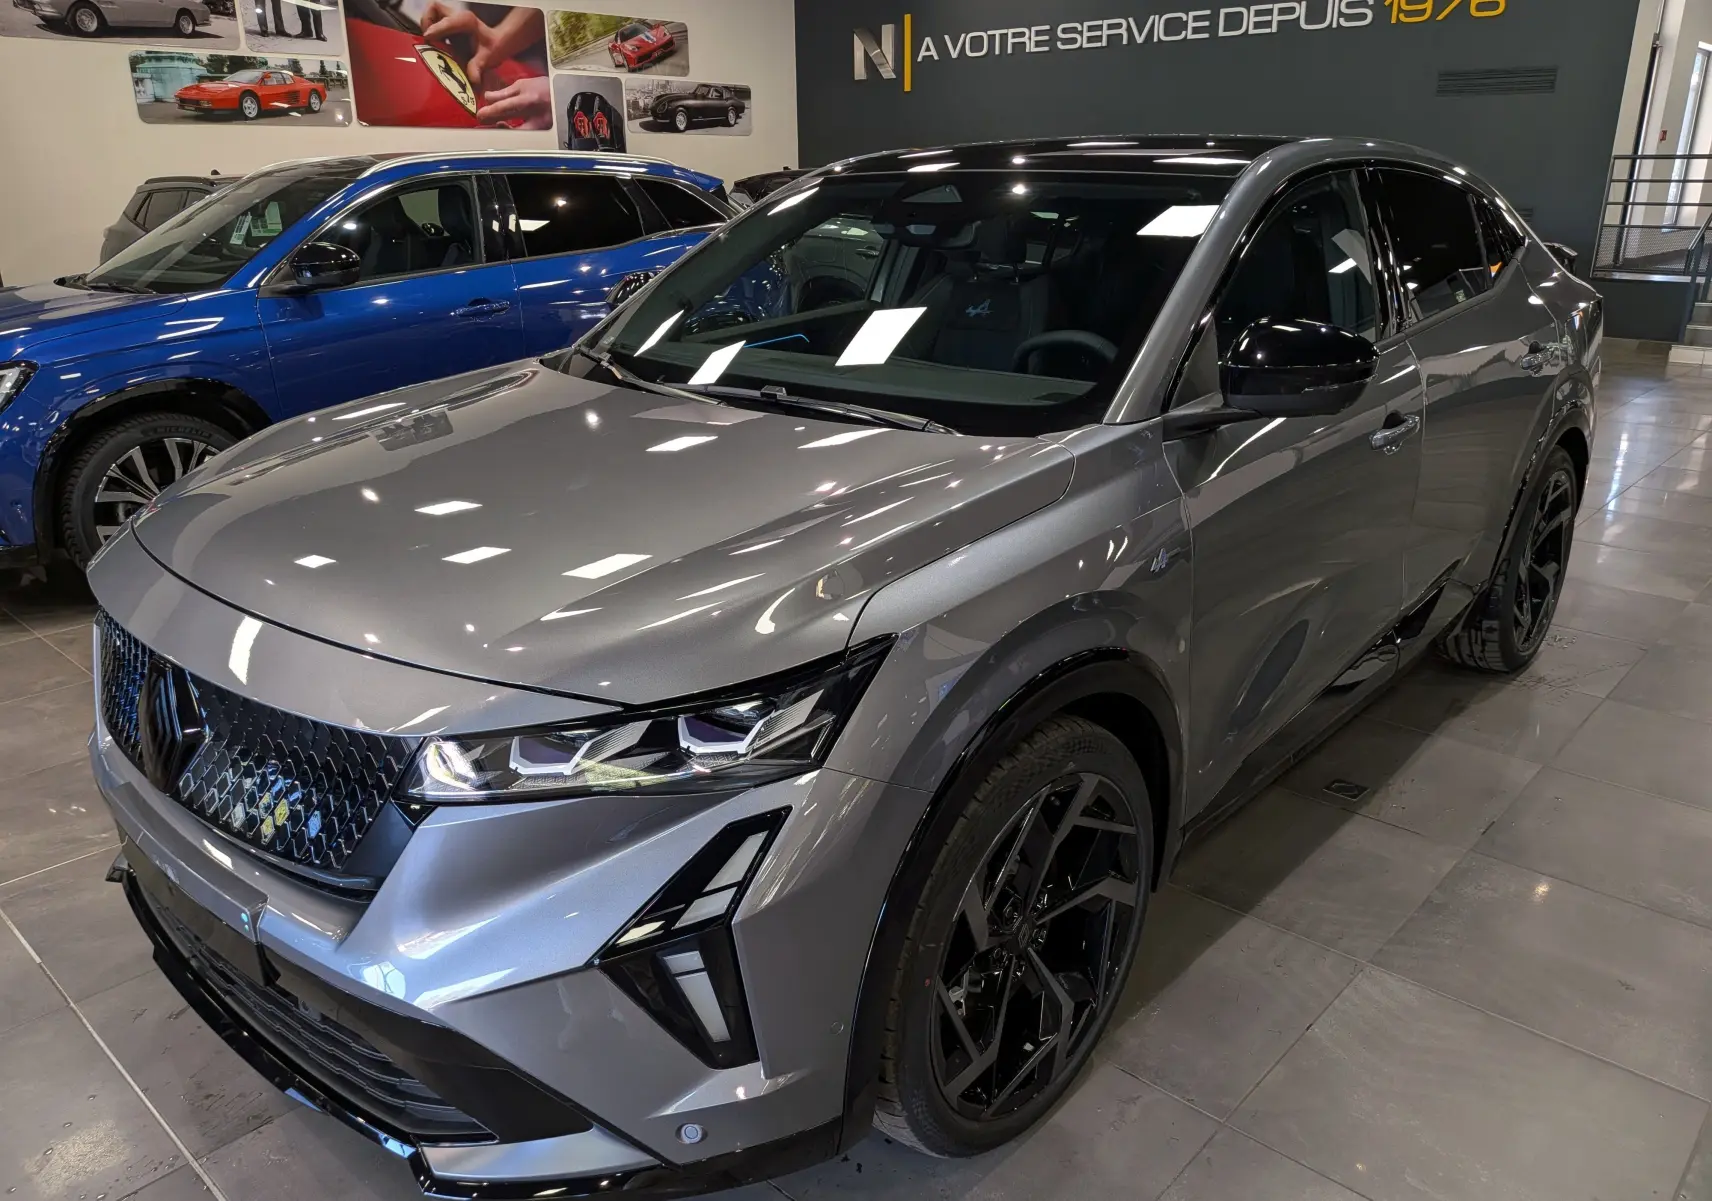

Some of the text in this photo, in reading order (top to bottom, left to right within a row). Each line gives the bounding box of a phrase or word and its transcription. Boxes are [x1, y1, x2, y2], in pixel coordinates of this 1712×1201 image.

[917, 36, 940, 62] A
[944, 25, 1051, 59] VOTRE
[1057, 10, 1212, 50] SERVICE
[1218, 0, 1374, 38] DEPUIS
